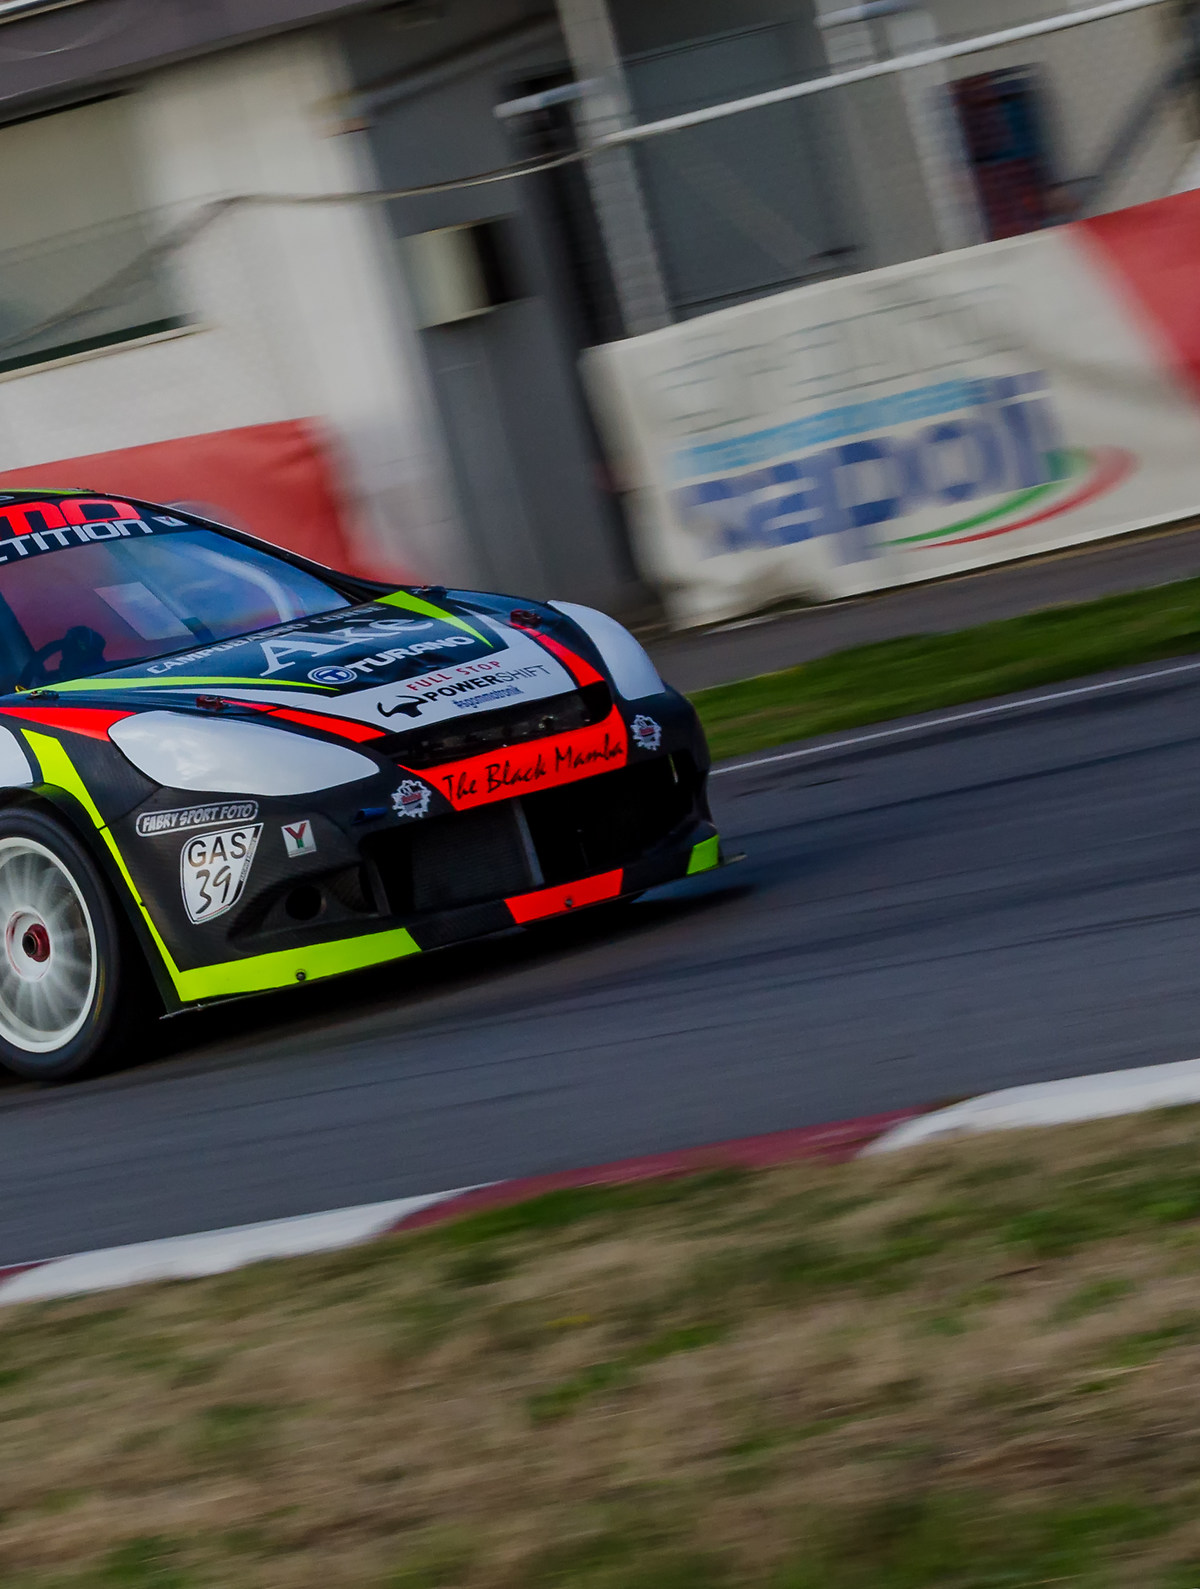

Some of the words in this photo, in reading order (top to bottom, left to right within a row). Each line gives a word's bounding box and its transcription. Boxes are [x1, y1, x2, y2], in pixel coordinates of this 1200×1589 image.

[147, 623, 308, 674] CAMPOBASSO
[345, 635, 475, 673] TURANO
[406, 672, 452, 691] FULL
[456, 661, 501, 676] STOP
[423, 664, 551, 701] POWERSHIFT
[442, 772, 477, 799] The
[485, 754, 546, 793] Black
[555, 733, 623, 772] Mamba
[143, 813, 178, 832] FABRY
[180, 807, 219, 826] SPORT
[220, 804, 253, 819] FOTO
[188, 831, 247, 867] GAS
[195, 865, 232, 914] 39
